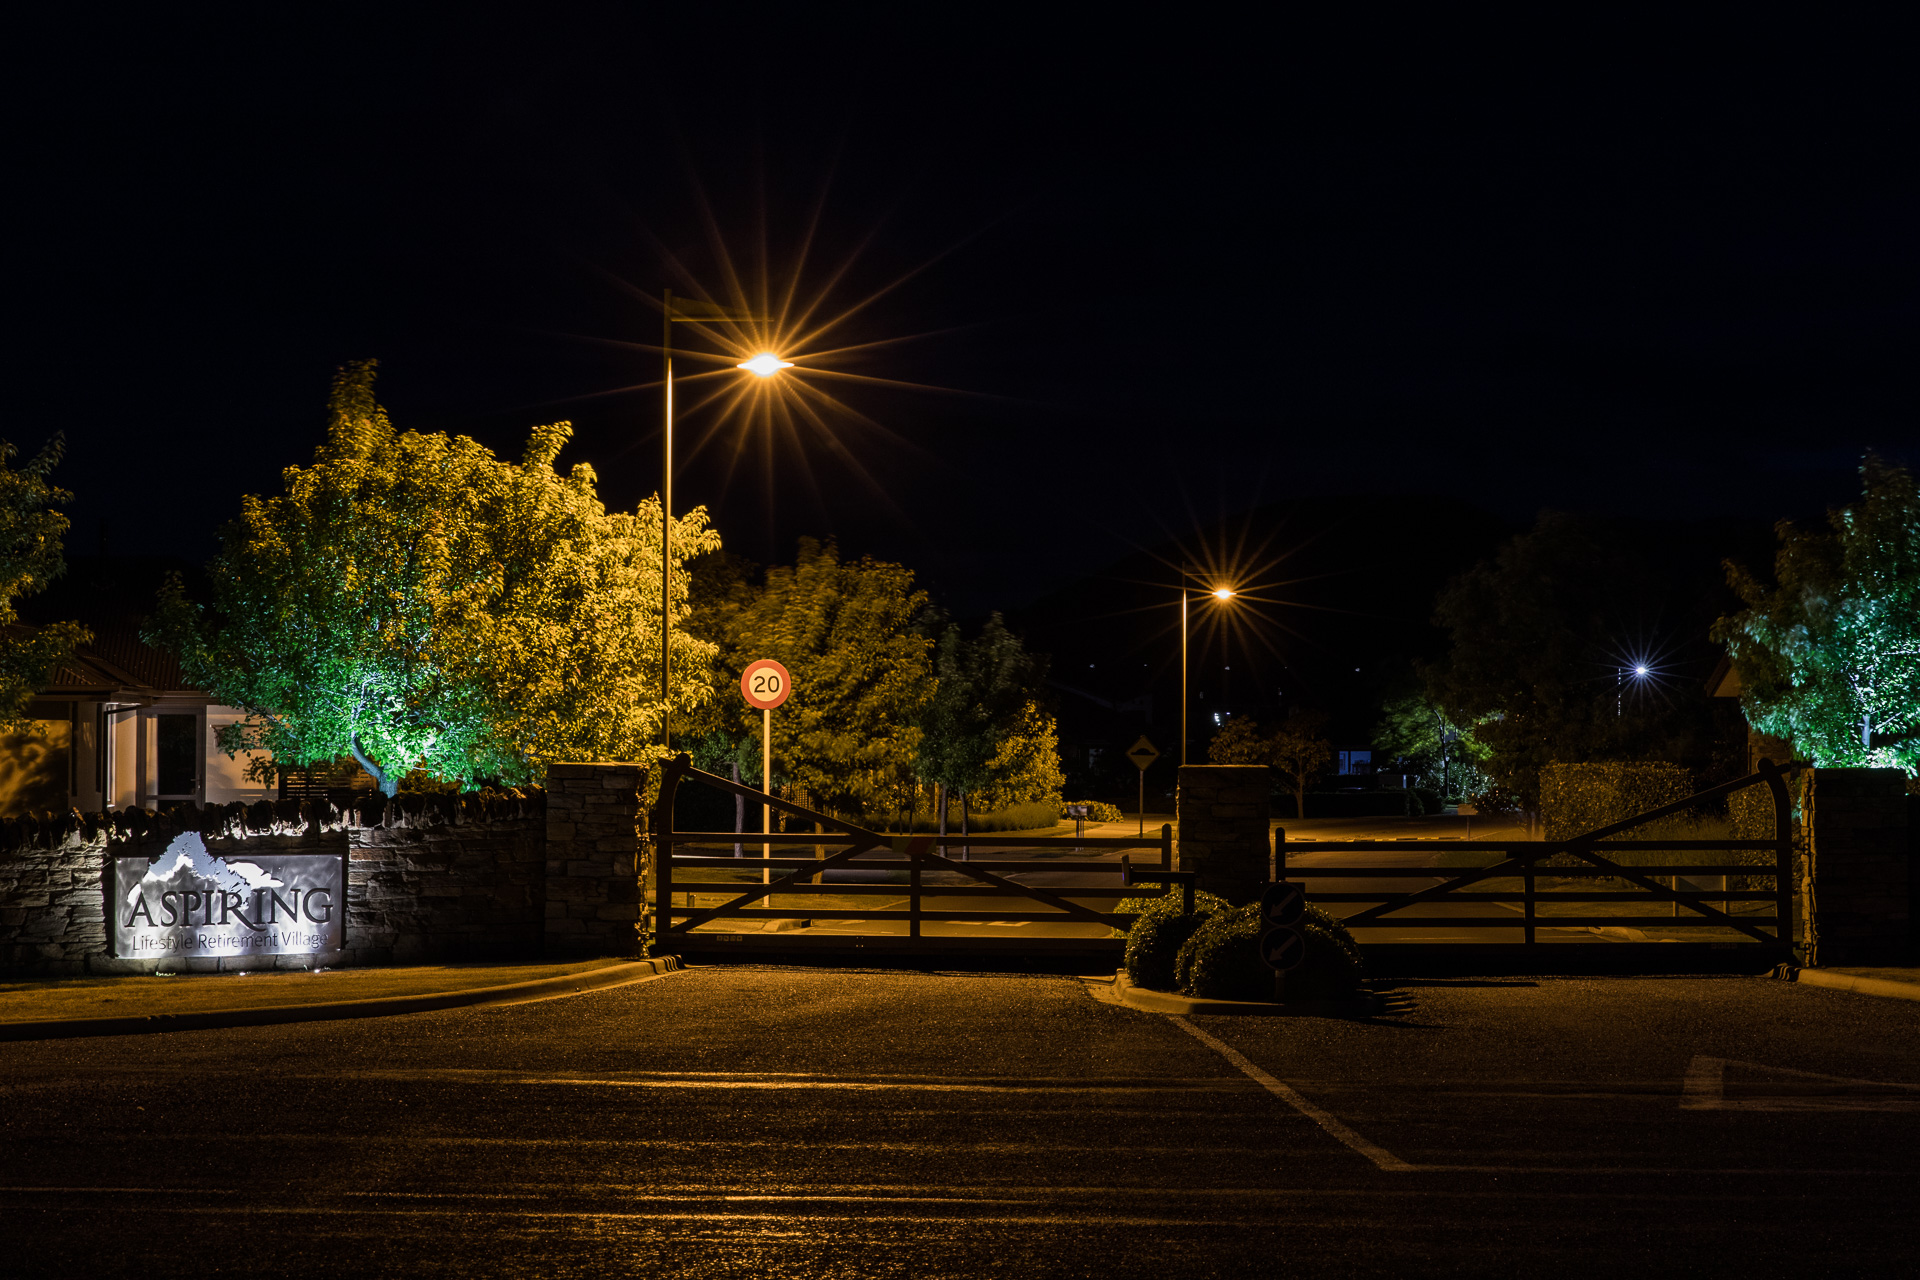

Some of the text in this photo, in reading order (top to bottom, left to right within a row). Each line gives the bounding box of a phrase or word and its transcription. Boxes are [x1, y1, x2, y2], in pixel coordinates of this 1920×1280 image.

[754, 675, 780, 693] 20
[124, 888, 333, 932] ASPIRING
[132, 931, 329, 953] Lifestyle Retirement Village
